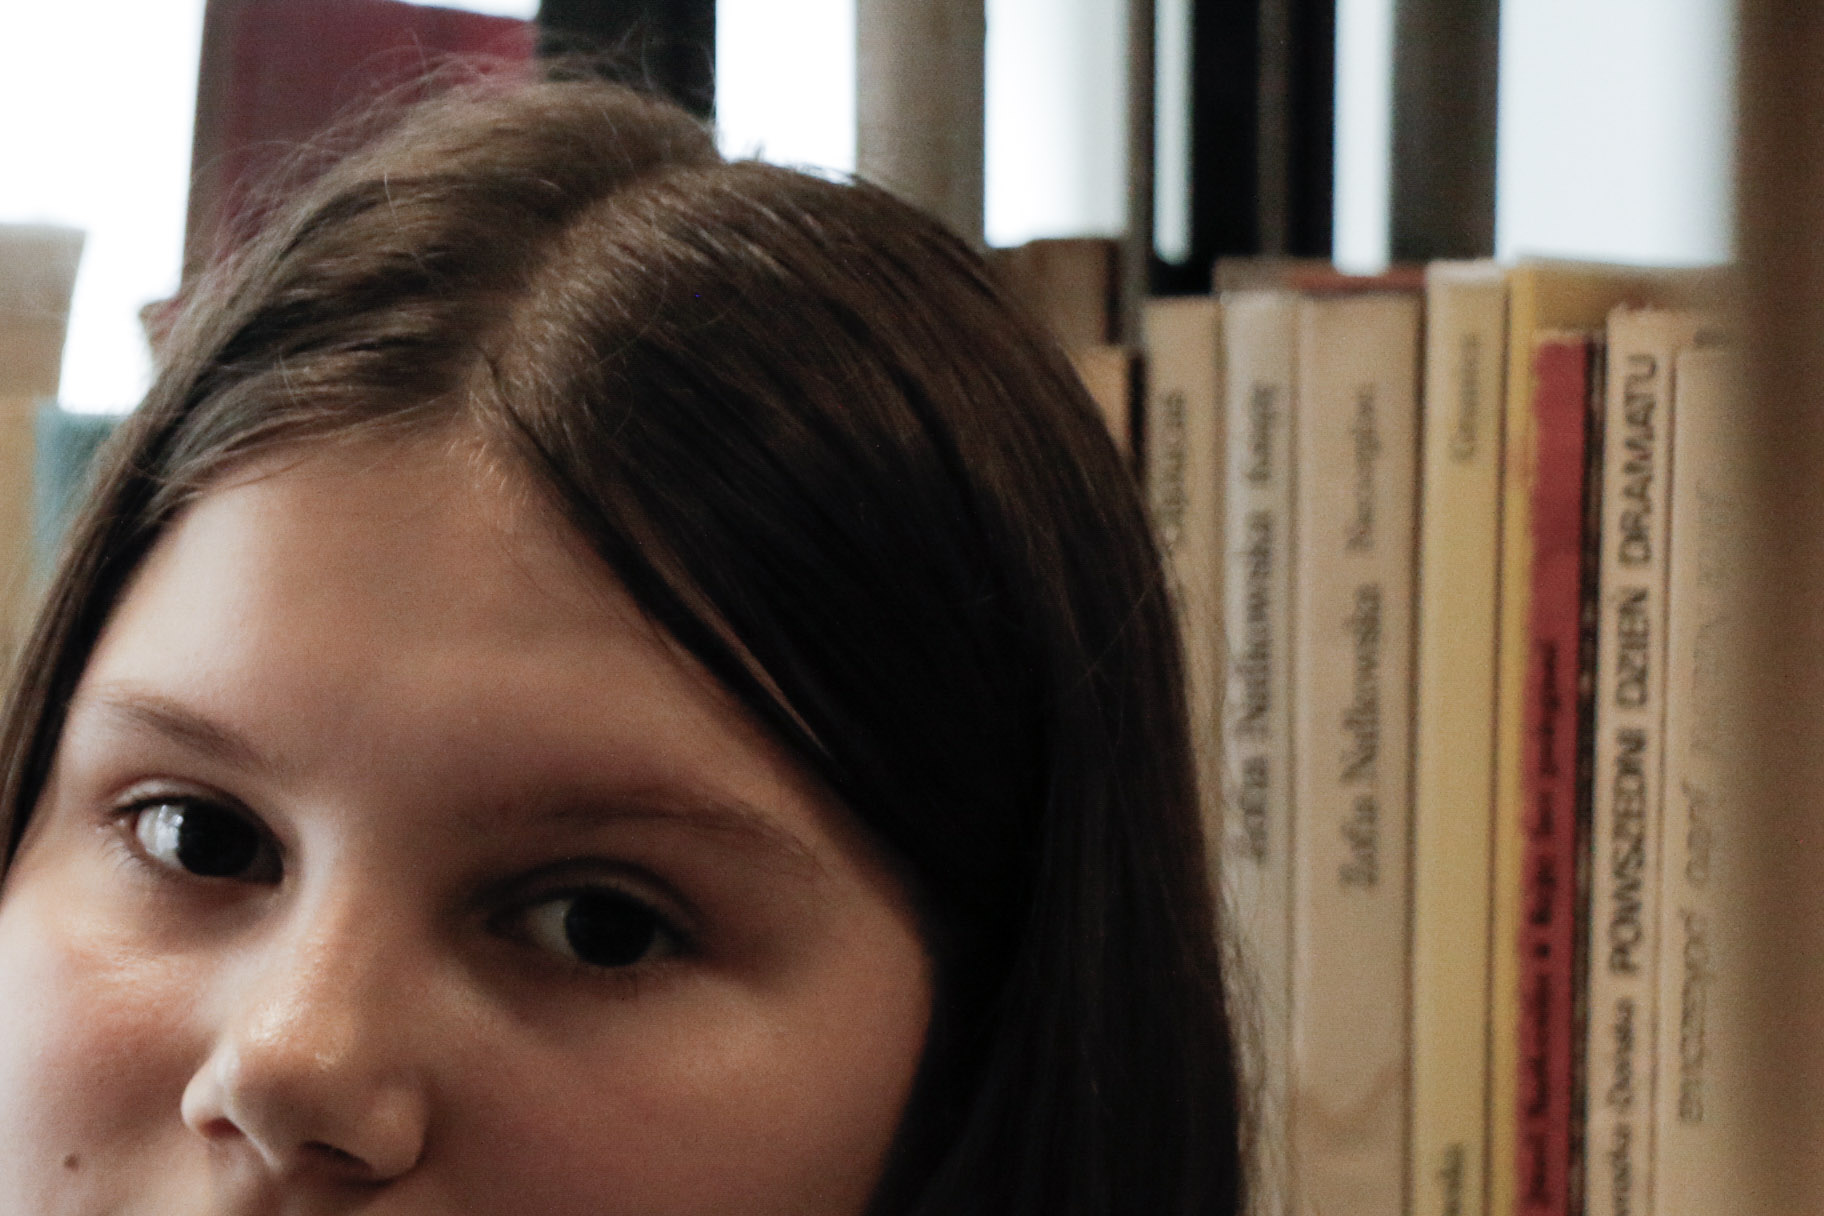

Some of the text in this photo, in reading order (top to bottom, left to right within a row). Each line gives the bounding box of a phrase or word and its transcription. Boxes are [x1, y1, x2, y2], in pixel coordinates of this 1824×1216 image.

[1618, 355, 1657, 565] DRAMATU
[1608, 590, 1648, 708] DZIEŃ
[1606, 731, 1645, 974] POWSZEDNI
